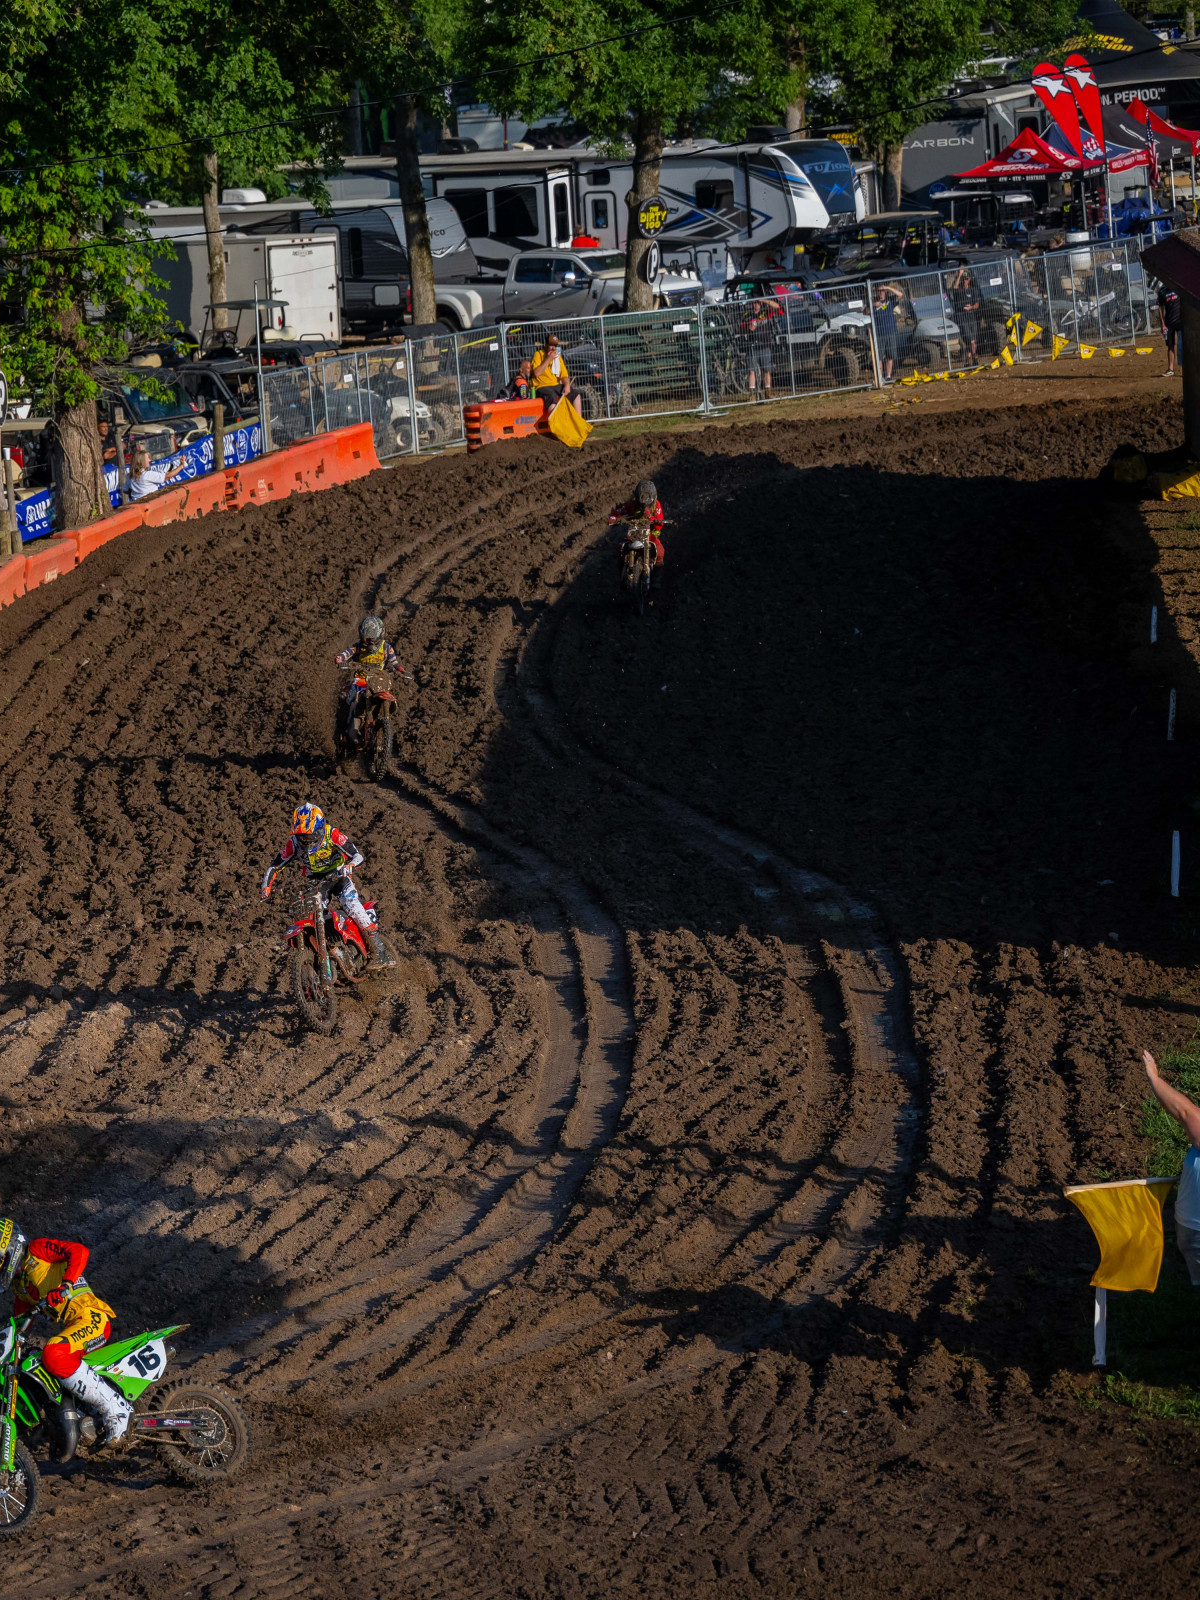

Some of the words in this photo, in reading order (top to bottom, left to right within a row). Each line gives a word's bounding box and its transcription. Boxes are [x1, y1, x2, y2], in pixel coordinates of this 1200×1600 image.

[640, 210, 667, 223] DIRTY
[645, 221, 661, 229] 100
[0, 1220, 12, 1249] OAKLEY
[127, 1345, 161, 1378] 16
[3, 1422, 11, 1460] DUNLOP
